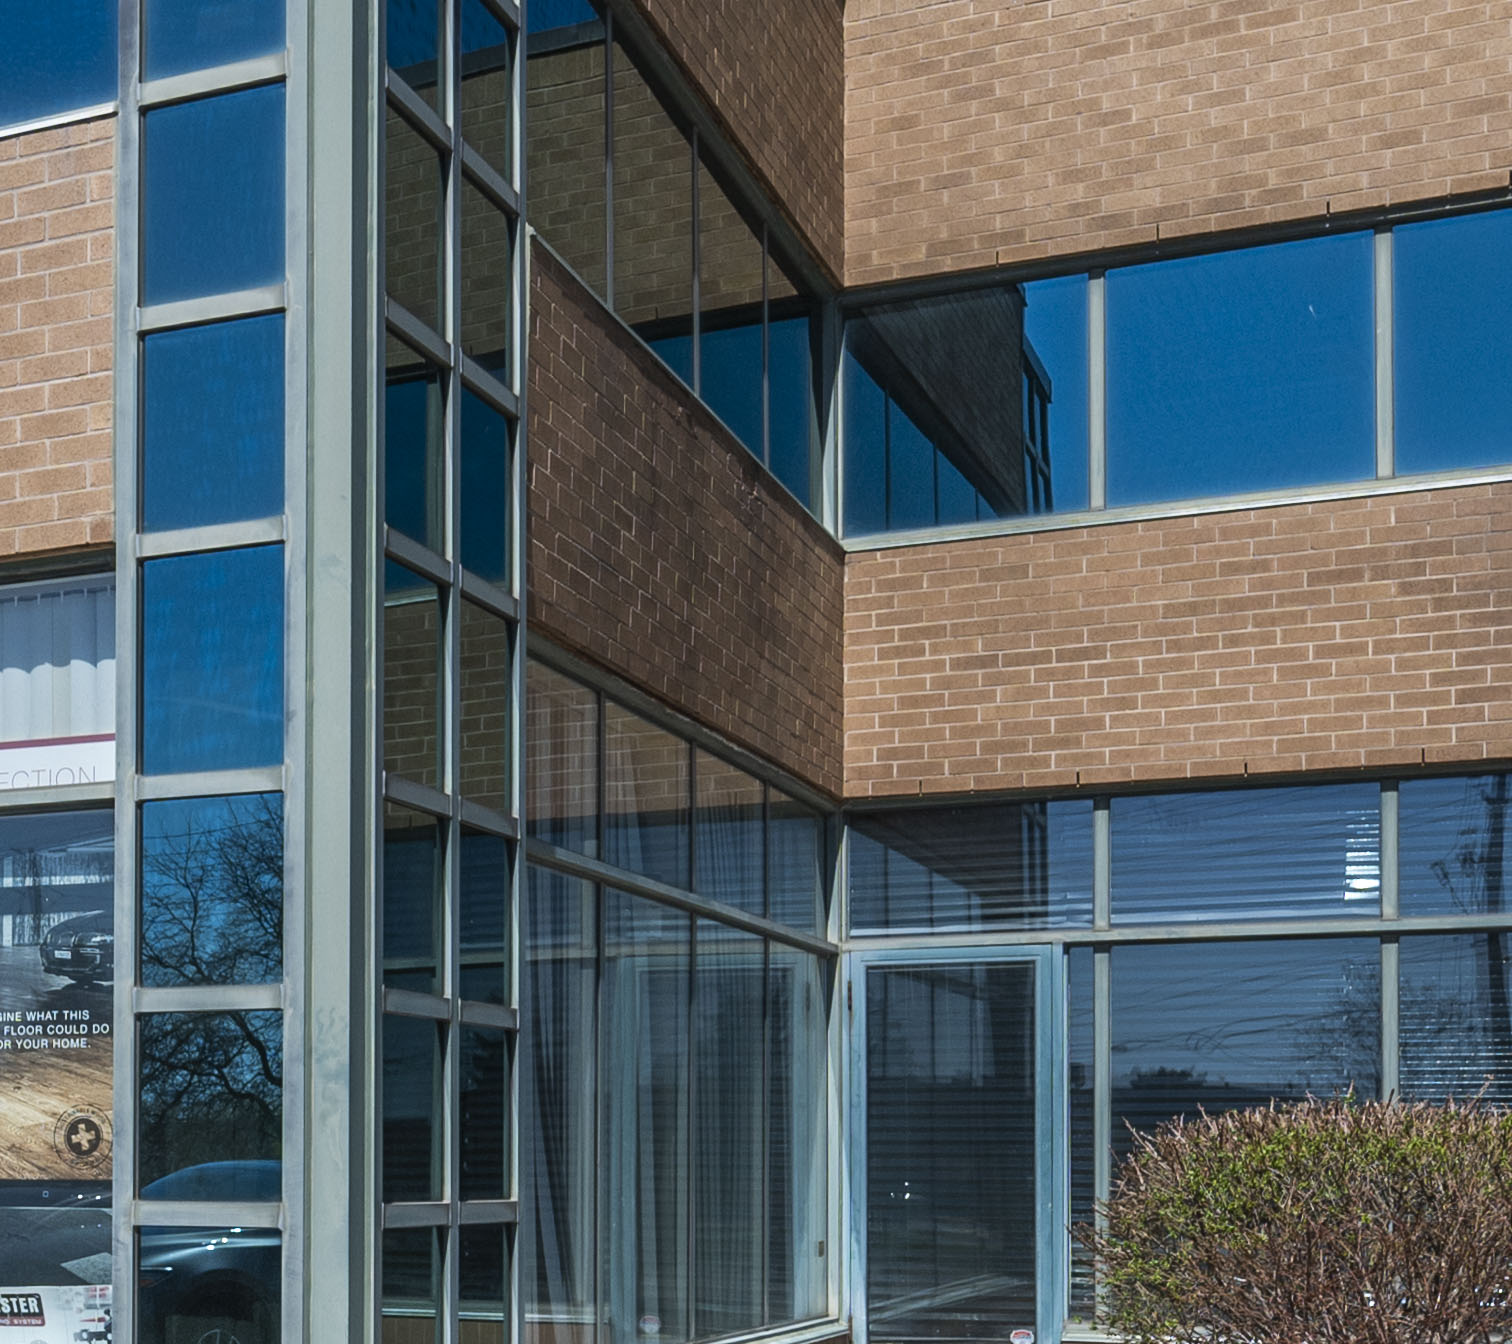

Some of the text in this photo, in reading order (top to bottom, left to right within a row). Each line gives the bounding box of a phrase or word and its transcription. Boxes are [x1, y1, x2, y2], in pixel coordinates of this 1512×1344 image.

[25, 1010, 59, 1022] WHAT
[62, 1009, 90, 1021] THIS
[3, 1023, 110, 1036] FLOOR COULD DO
[15, 1038, 49, 1050] YOUR
[52, 1037, 92, 1049] HOME.
